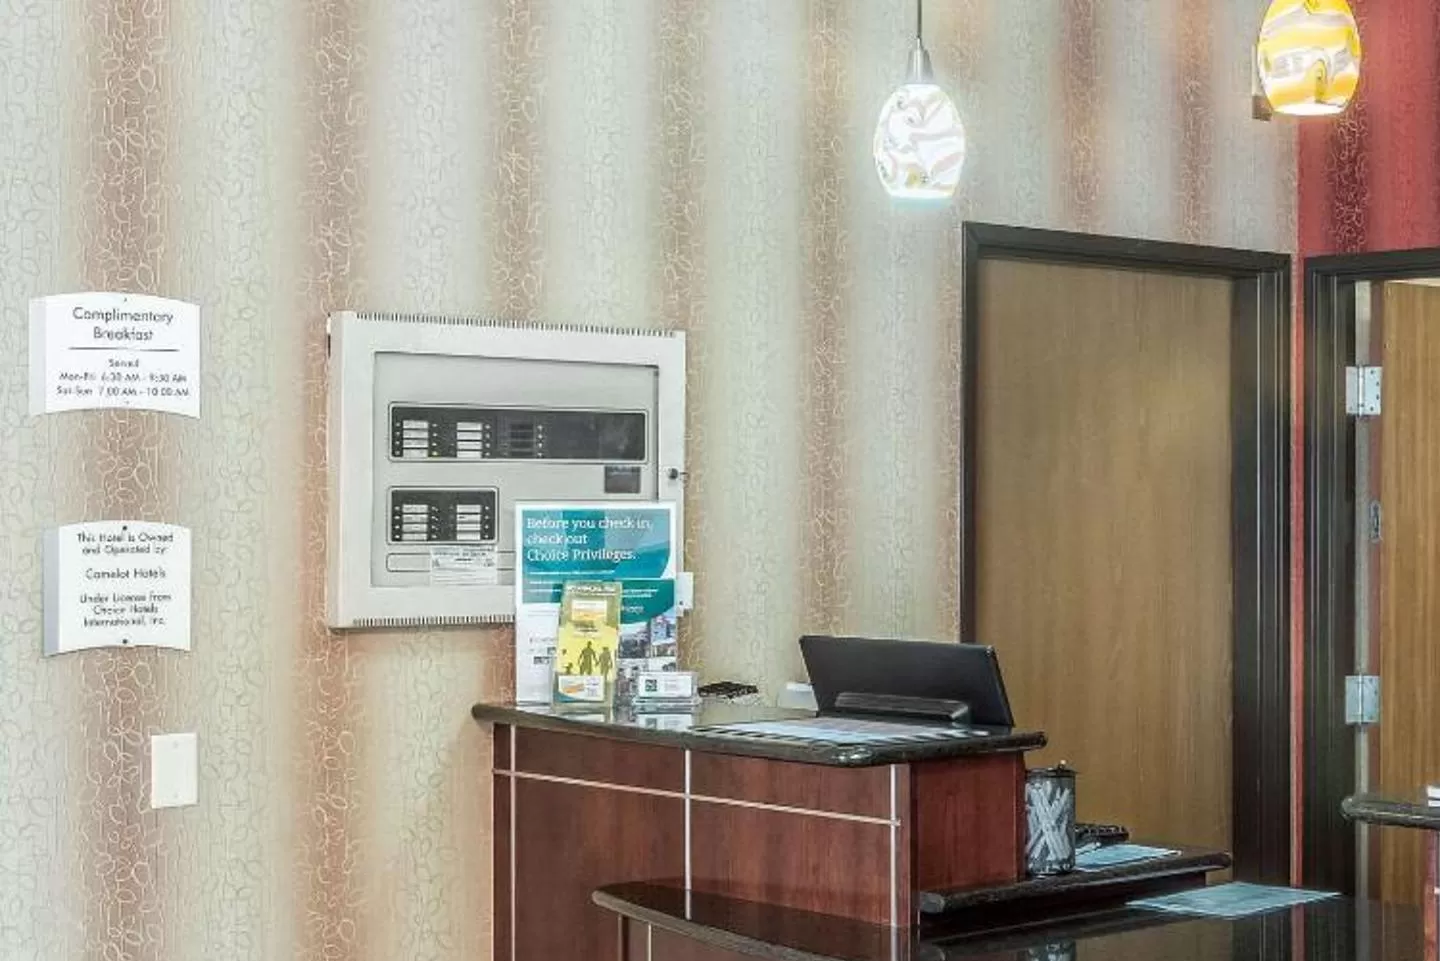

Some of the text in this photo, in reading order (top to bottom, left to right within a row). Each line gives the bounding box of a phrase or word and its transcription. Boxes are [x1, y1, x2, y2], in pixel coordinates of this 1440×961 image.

[72, 306, 174, 325] Complimentary
[93, 326, 154, 341] Breakfast
[526, 517, 569, 530] Before
[572, 518, 596, 532] you
[598, 516, 636, 530] check
[77, 533, 95, 542] This
[99, 532, 124, 542] Hotel
[138, 532, 174, 542] Owned
[526, 533, 589, 545] check out
[526, 549, 638, 563] Choice Privileges.
[85, 567, 166, 579] Camelot Hotels
[80, 593, 109, 603] Under
